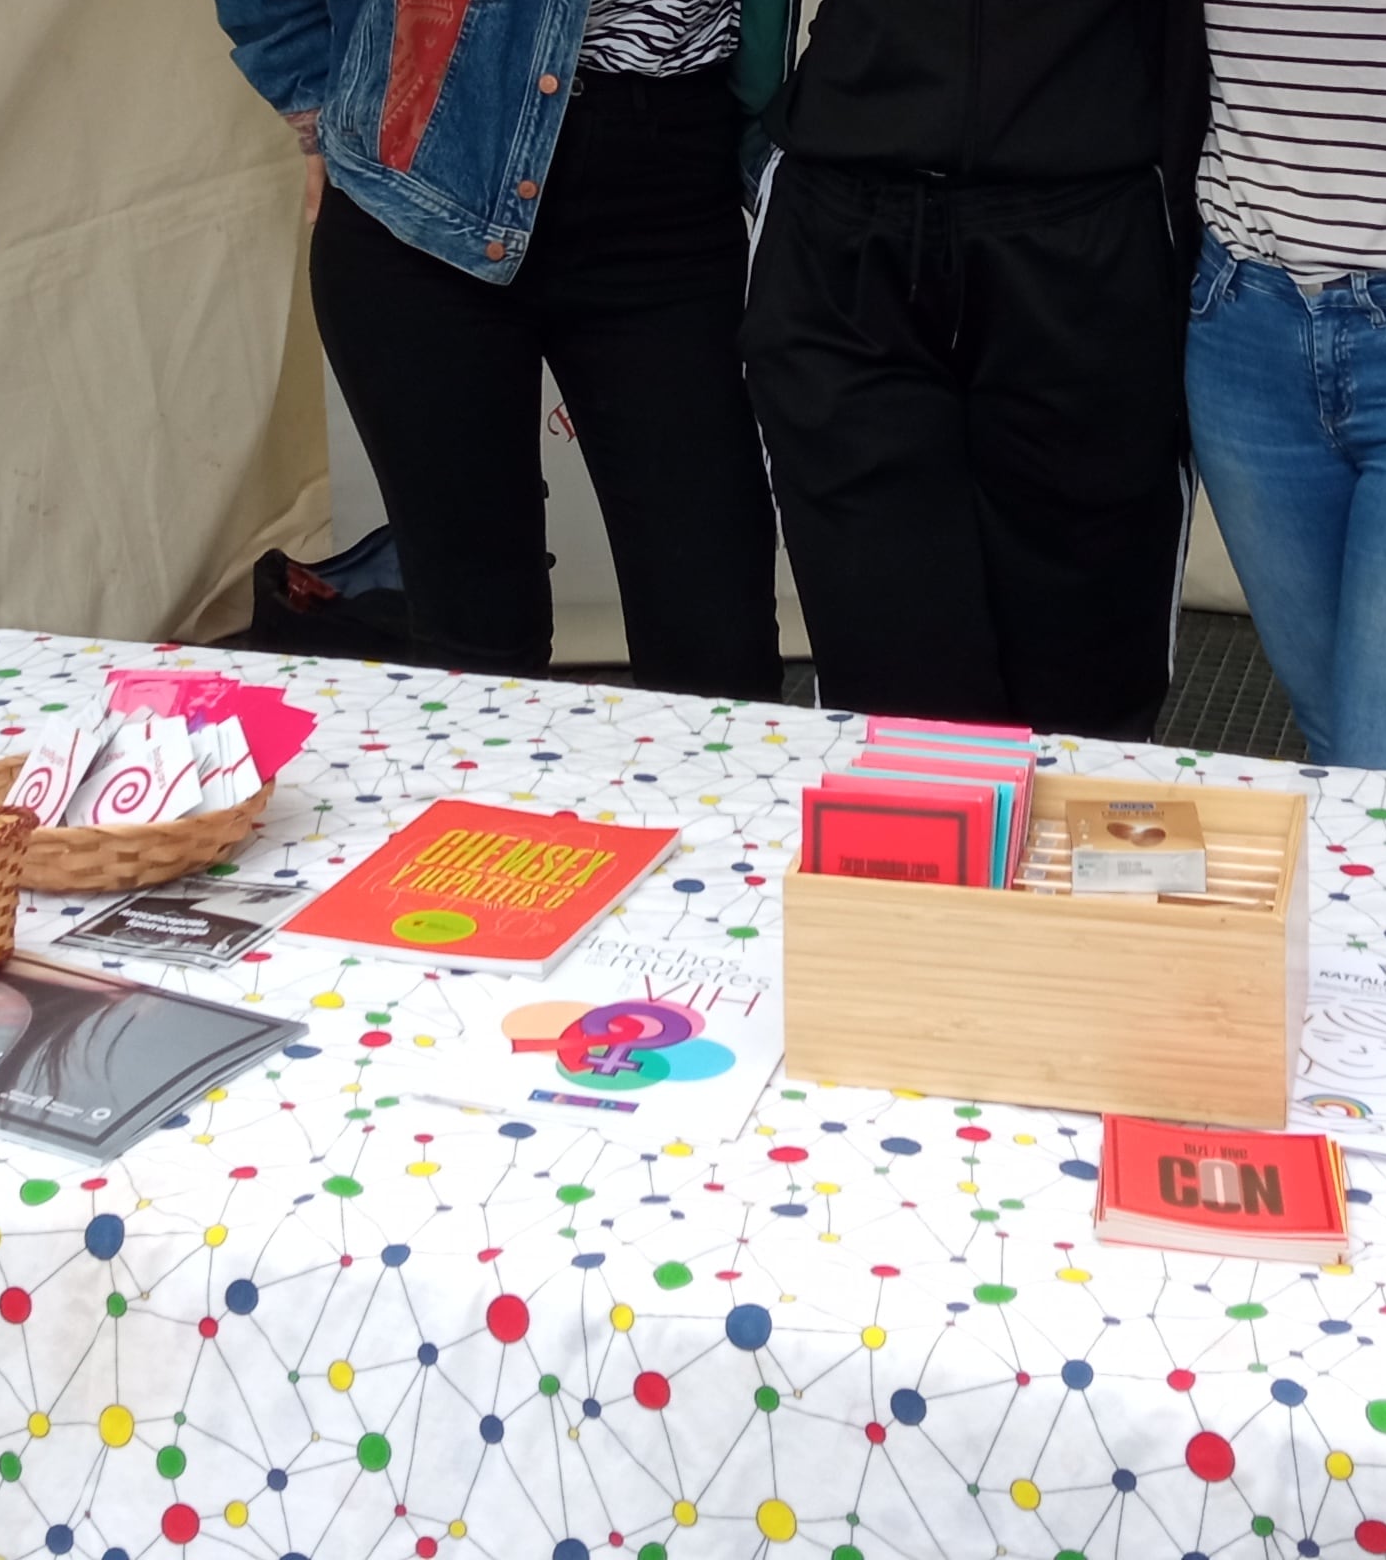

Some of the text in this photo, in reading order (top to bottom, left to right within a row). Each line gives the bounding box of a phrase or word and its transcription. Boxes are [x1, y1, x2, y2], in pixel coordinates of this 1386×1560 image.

[414, 829, 616, 887] CHEMSEX
[389, 861, 576, 911] Y HEPATITIS C
[609, 954, 774, 992] mujeres
[645, 973, 762, 1018] VIH
[1157, 1154, 1286, 1217] CON
